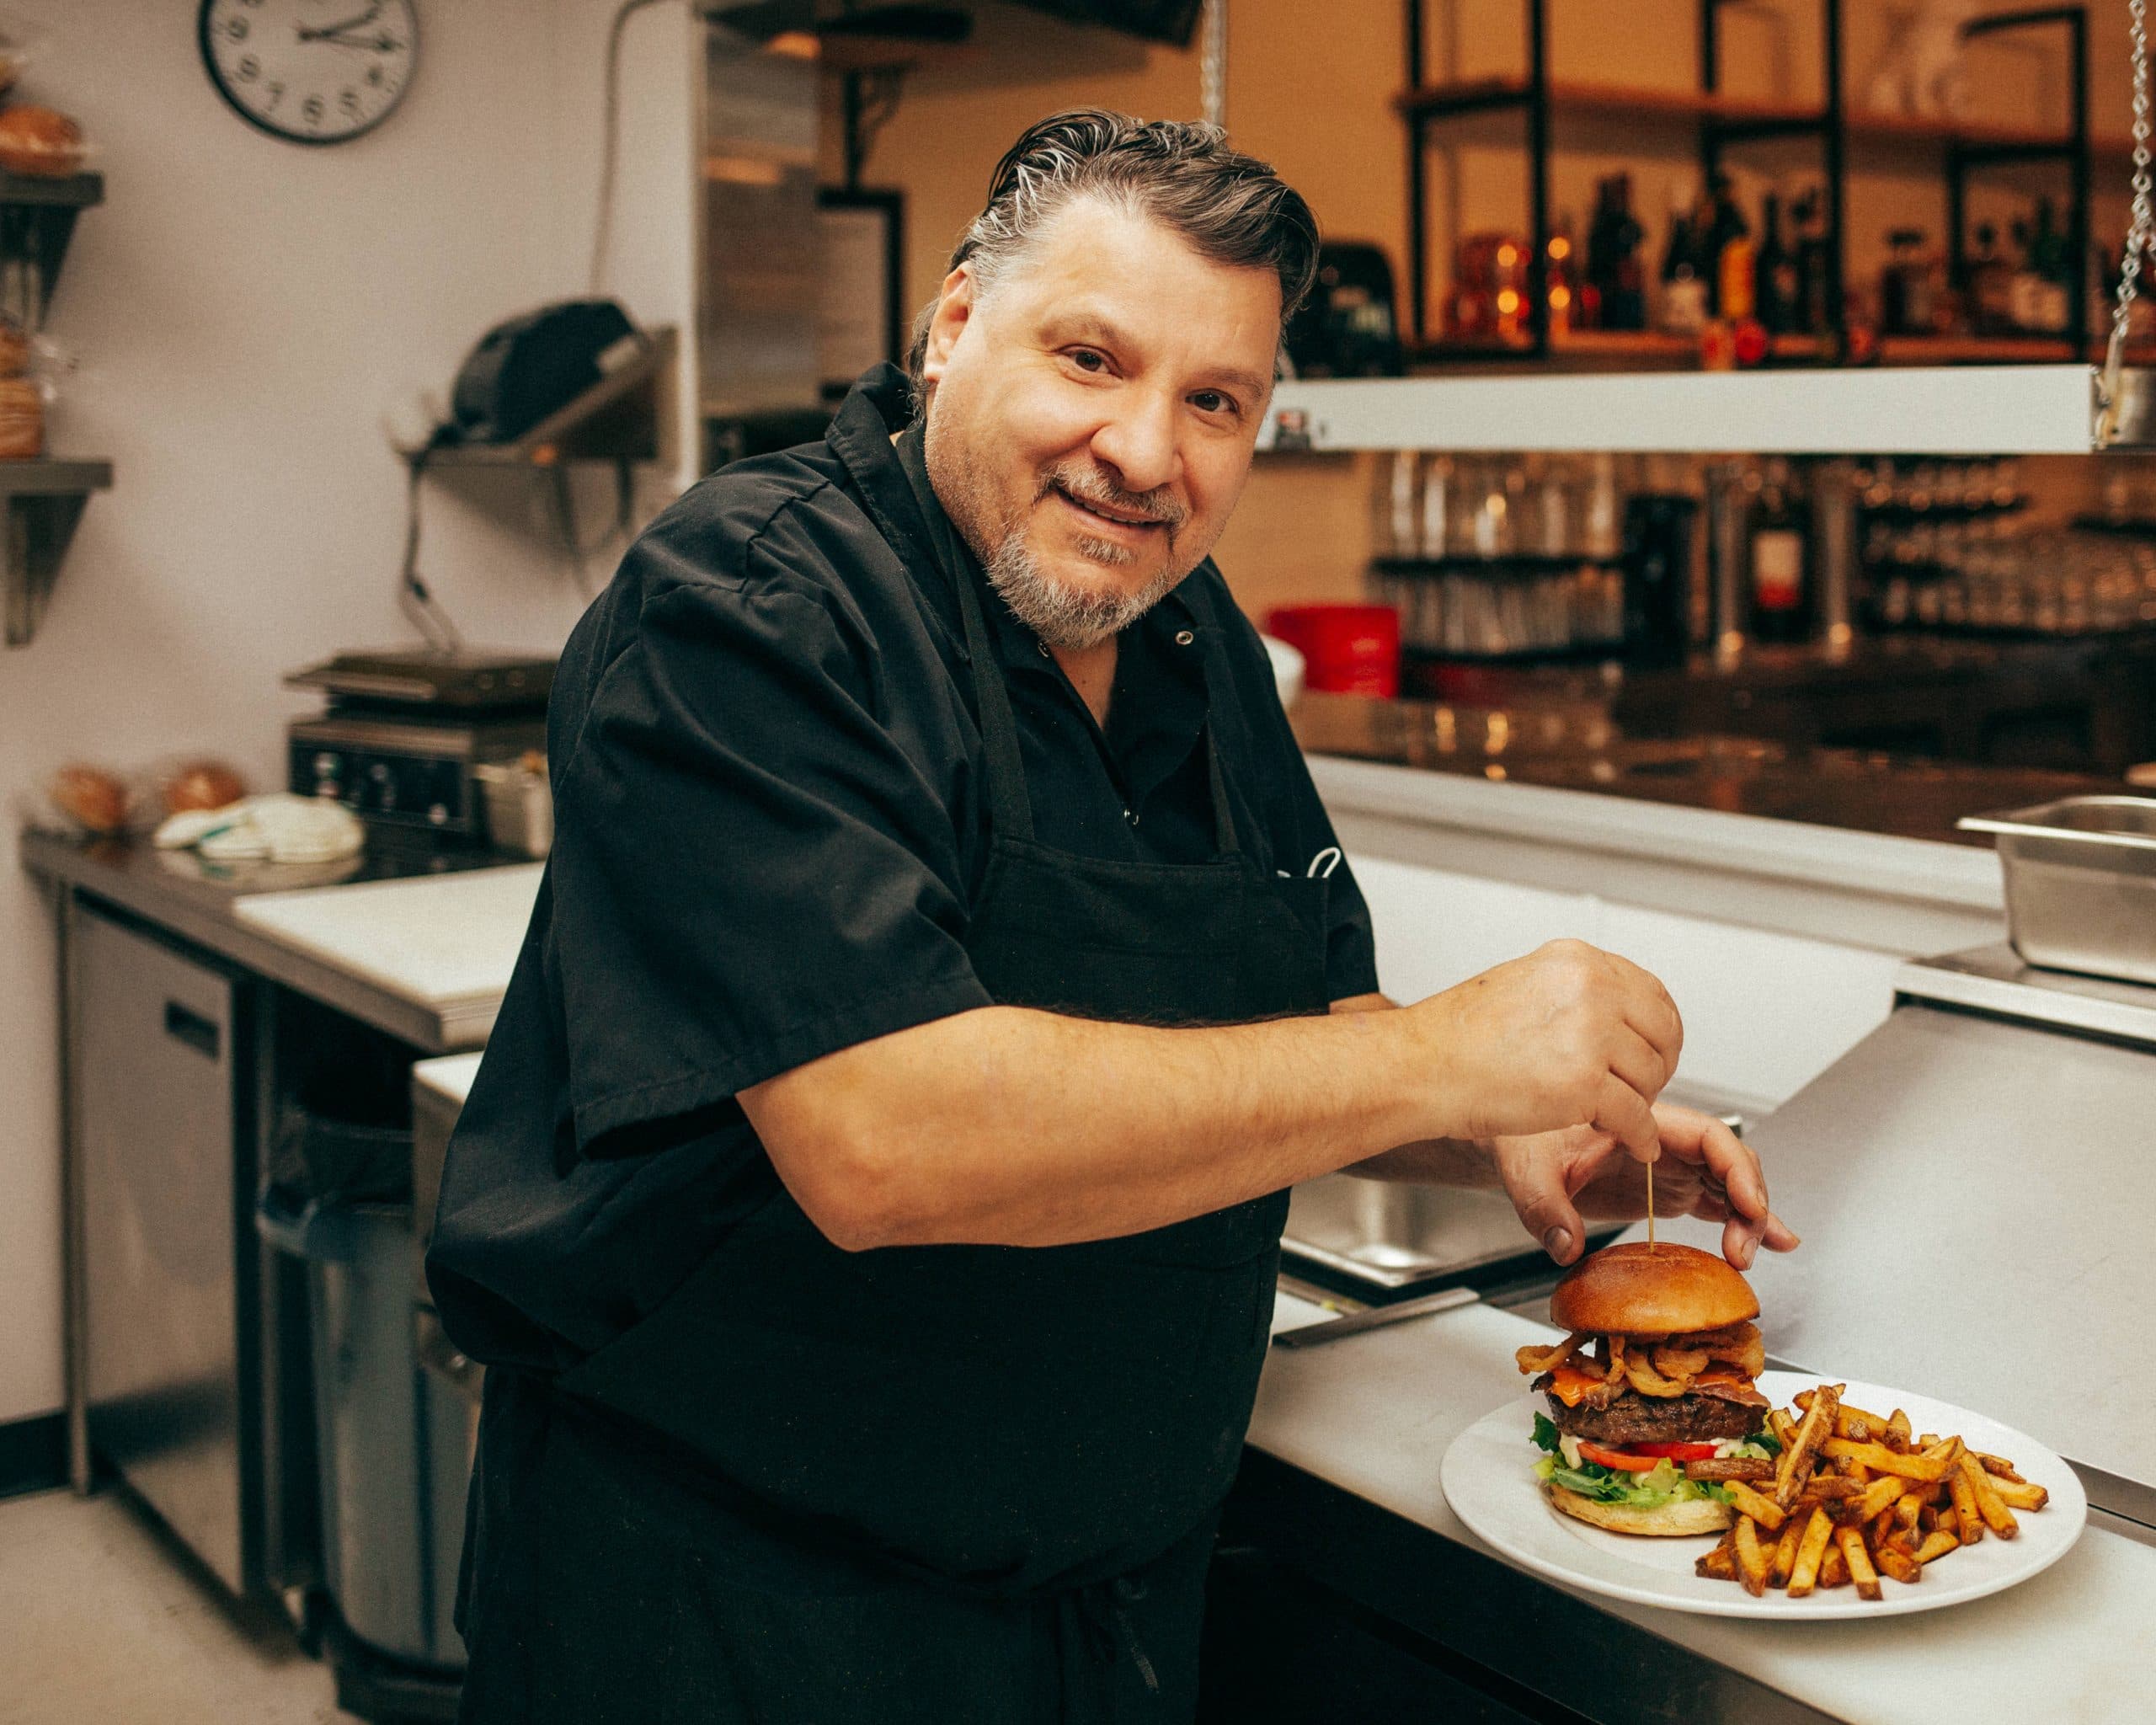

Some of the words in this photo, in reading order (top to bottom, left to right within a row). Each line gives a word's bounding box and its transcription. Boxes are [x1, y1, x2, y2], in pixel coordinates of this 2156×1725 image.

[268, 81, 286, 111] 7
[302, 93, 323, 125] 6
[339, 88, 360, 115] 5
